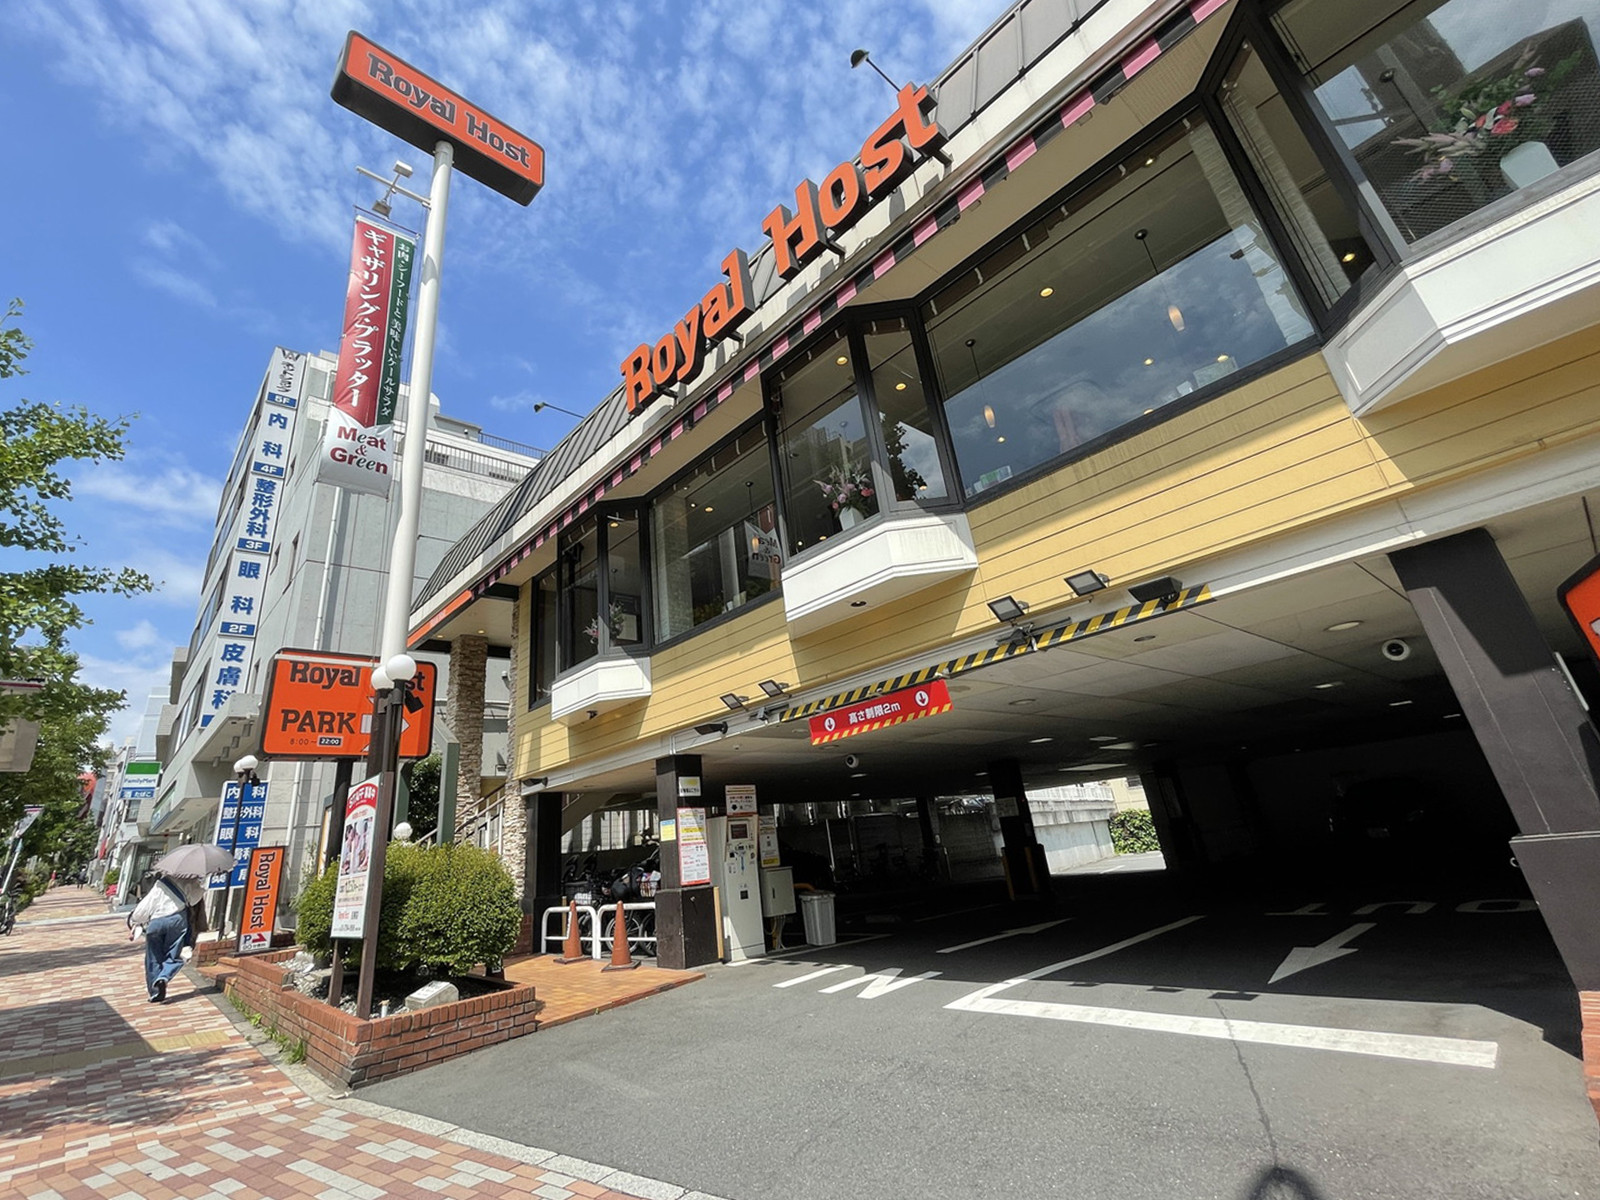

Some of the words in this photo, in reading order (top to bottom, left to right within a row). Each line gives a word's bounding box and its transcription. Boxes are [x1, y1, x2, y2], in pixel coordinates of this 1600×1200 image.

[366, 52, 456, 125] Royal
[465, 111, 531, 169] Host
[620, 247, 752, 416] Royal
[761, 81, 946, 281] Host
[262, 412, 288, 459] 内科
[337, 425, 387, 452] Meat
[355, 444, 369, 457] &
[260, 464, 277, 474] 4F
[330, 446, 388, 475] Green
[245, 478, 276, 539] 整形外科
[245, 540, 264, 551] 3F
[231, 560, 261, 616] 眼科
[229, 624, 248, 634] 2F
[211, 643, 246, 709] 皮膚科
[289, 660, 361, 690] Royal
[280, 708, 357, 734] PARK
[848, 701, 901, 725] 高さ制限2m
[252, 851, 275, 891] Royal
[249, 893, 270, 929] Host
